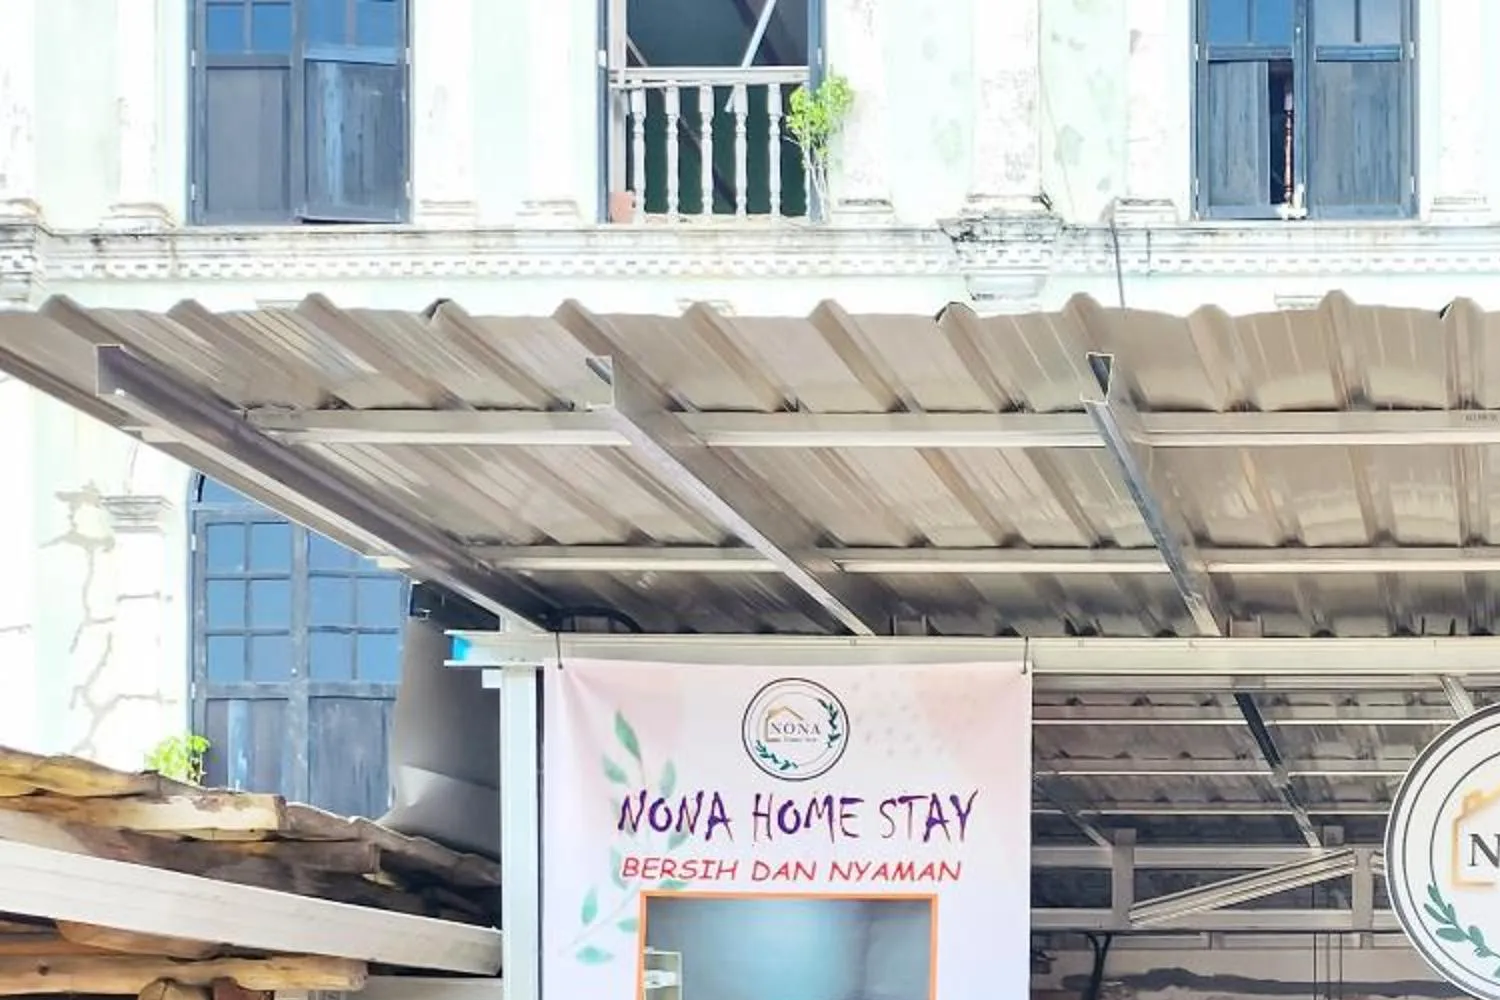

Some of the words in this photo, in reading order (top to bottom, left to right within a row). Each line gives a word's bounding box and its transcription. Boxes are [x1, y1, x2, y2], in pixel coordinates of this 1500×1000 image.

[770, 722, 821, 735] NONA
[617, 789, 734, 841] NONA
[752, 792, 864, 843] HOME
[879, 789, 979, 842] STAY
[622, 857, 739, 882] BERSIH
[752, 860, 817, 882] DAN
[829, 860, 961, 882] NYAMAN
